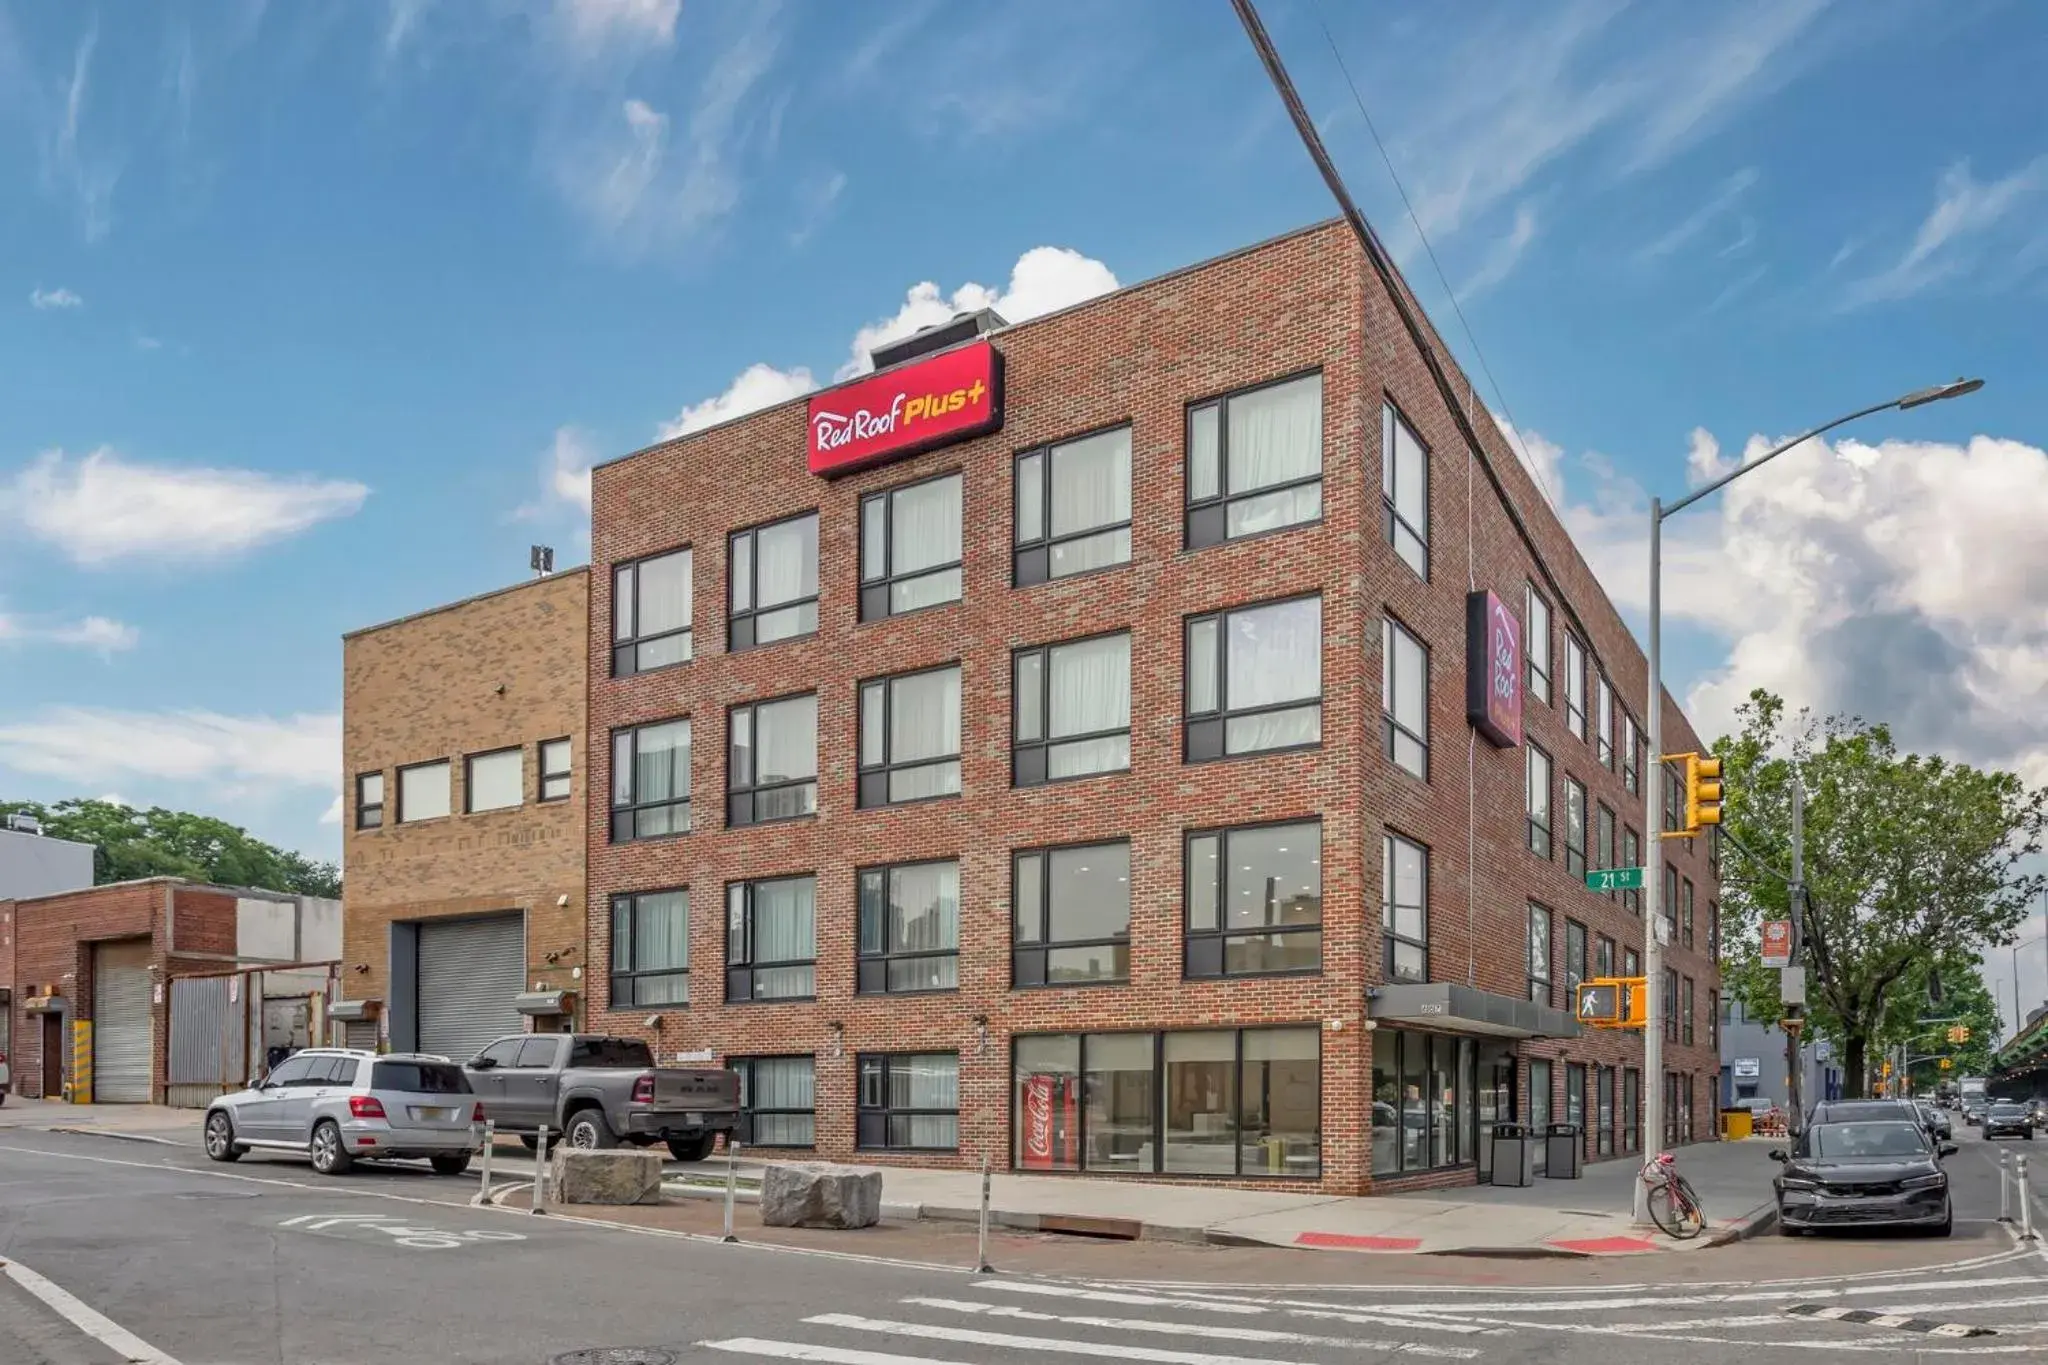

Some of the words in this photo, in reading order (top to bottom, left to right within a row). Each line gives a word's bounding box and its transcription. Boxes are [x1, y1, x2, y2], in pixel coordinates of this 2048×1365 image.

[1495, 628, 1513, 671] Red
[1494, 661, 1516, 709] Roof
[1601, 873, 1615, 888] 21
